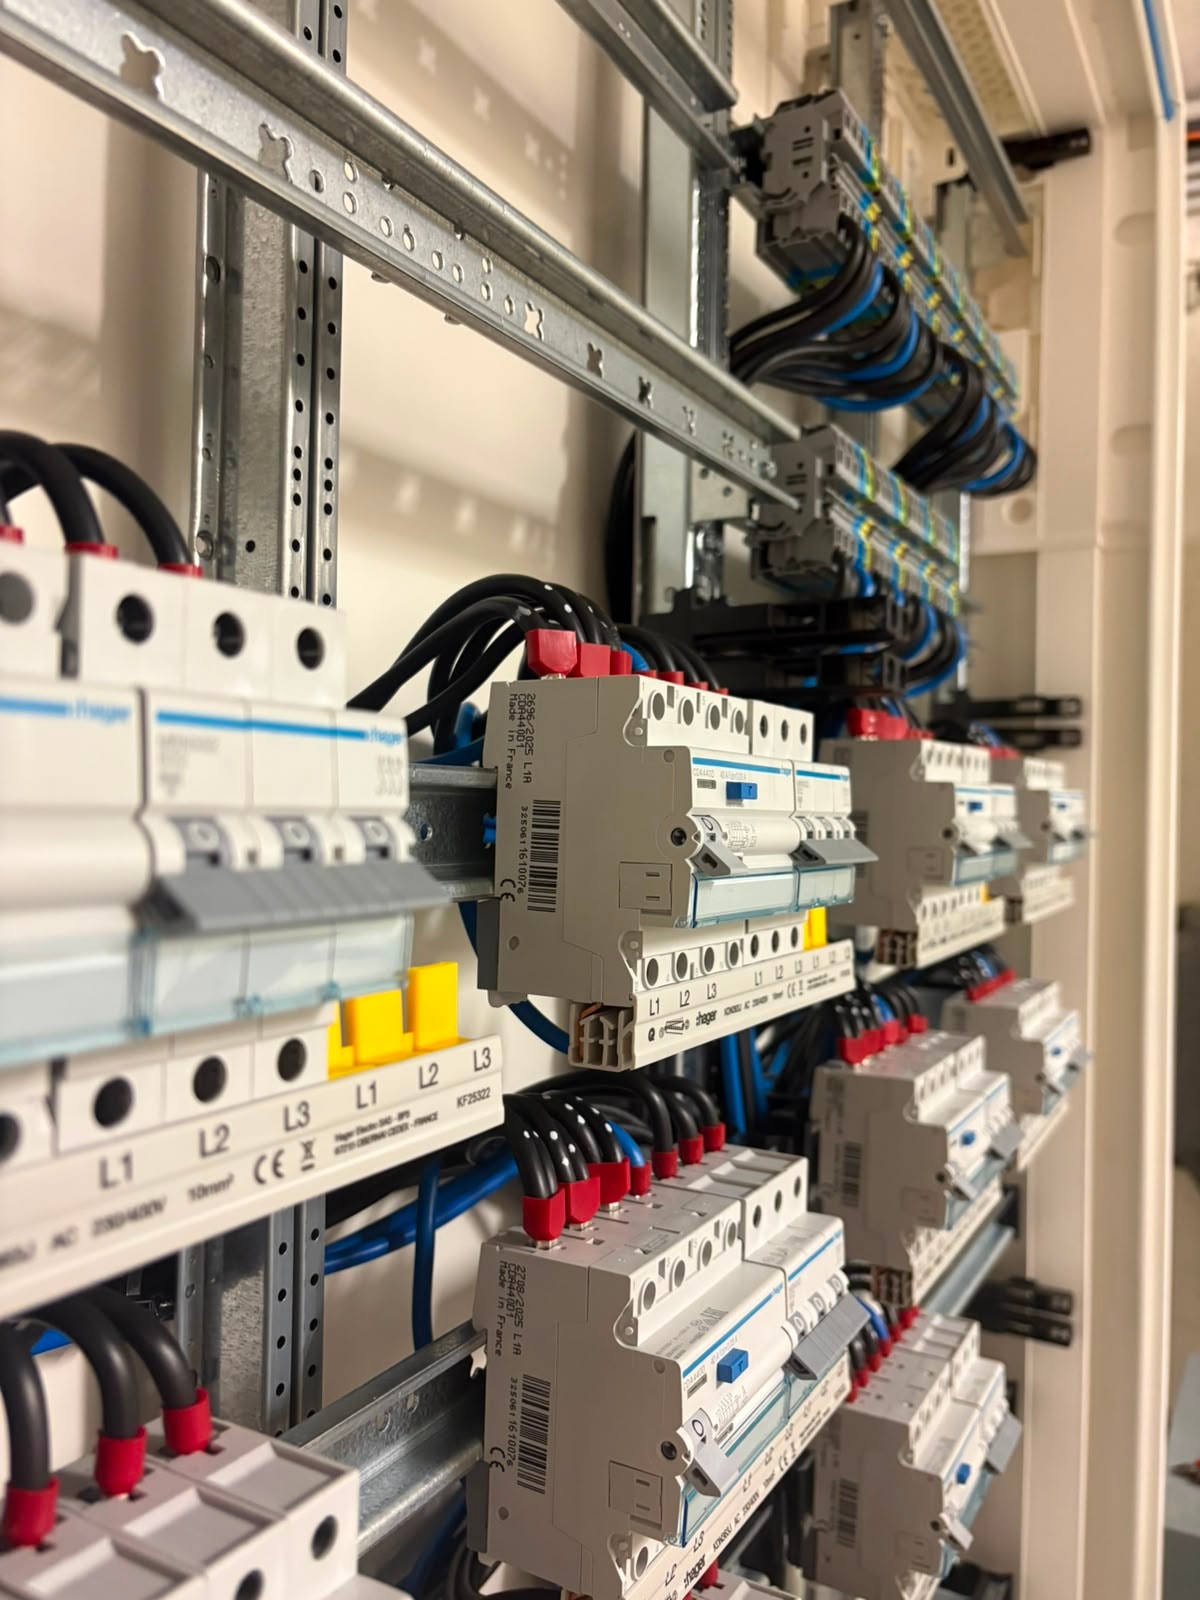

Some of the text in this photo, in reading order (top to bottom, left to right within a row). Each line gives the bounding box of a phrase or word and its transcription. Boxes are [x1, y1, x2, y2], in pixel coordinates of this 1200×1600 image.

[505, 694, 518, 790] Made in France
[524, 693, 536, 756] 2696/2025
[649, 997, 660, 1016] L1
[679, 989, 691, 1008] L2
[706, 982, 717, 1000] L3
[754, 971, 763, 986] L1
[775, 964, 784, 980] L2
[99, 1046, 493, 1190] L1 L2 L3 L1 L2 L3
[456, 1087, 492, 1109] KF25322
[495, 1260, 509, 1357] Made in France
[665, 1563, 677, 1587] L2
[693, 1530, 705, 1553] L3
